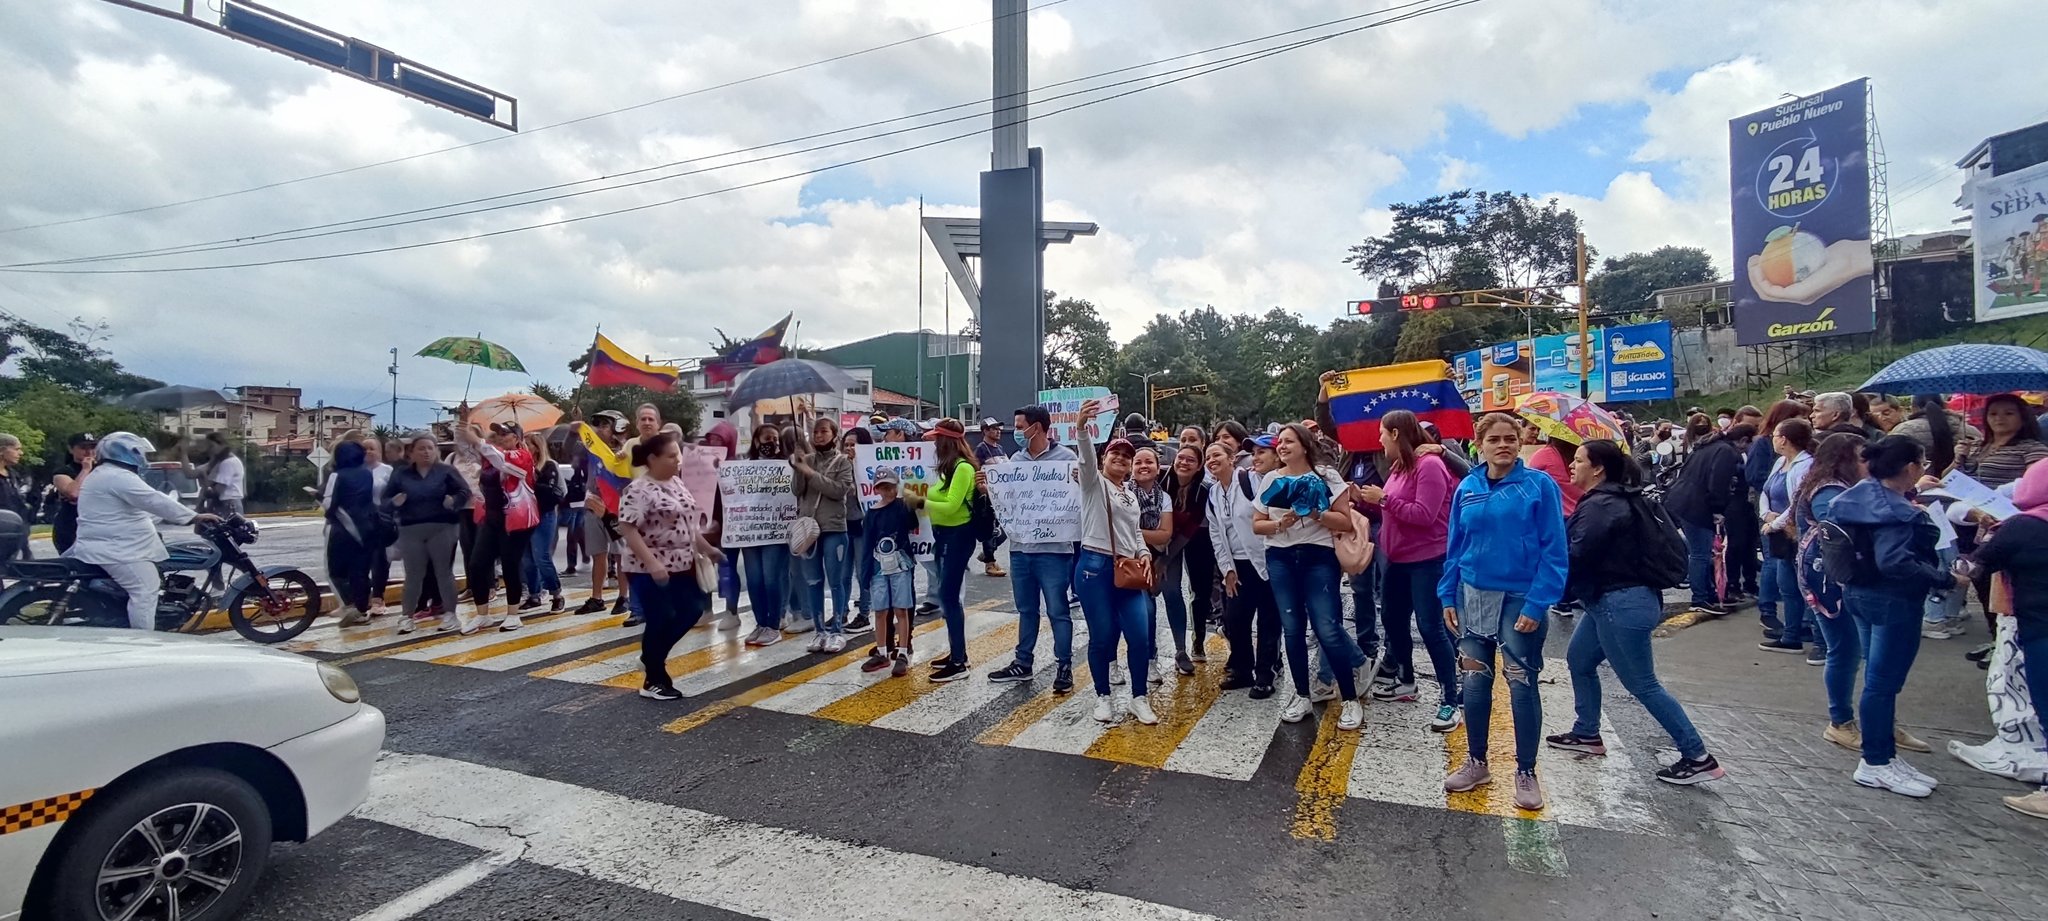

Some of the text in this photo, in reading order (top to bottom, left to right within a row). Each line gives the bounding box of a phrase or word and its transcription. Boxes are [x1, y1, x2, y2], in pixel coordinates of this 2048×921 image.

[1760, 100, 1843, 134] Pueblo Nuevo
[1775, 92, 1825, 117] Sucursal
[1768, 146, 1824, 194] 24
[1768, 183, 1827, 210] HORAS
[1990, 192, 2048, 219] SEBA
[1402, 295, 1418, 308] 20
[1767, 308, 1836, 337] Garzón
